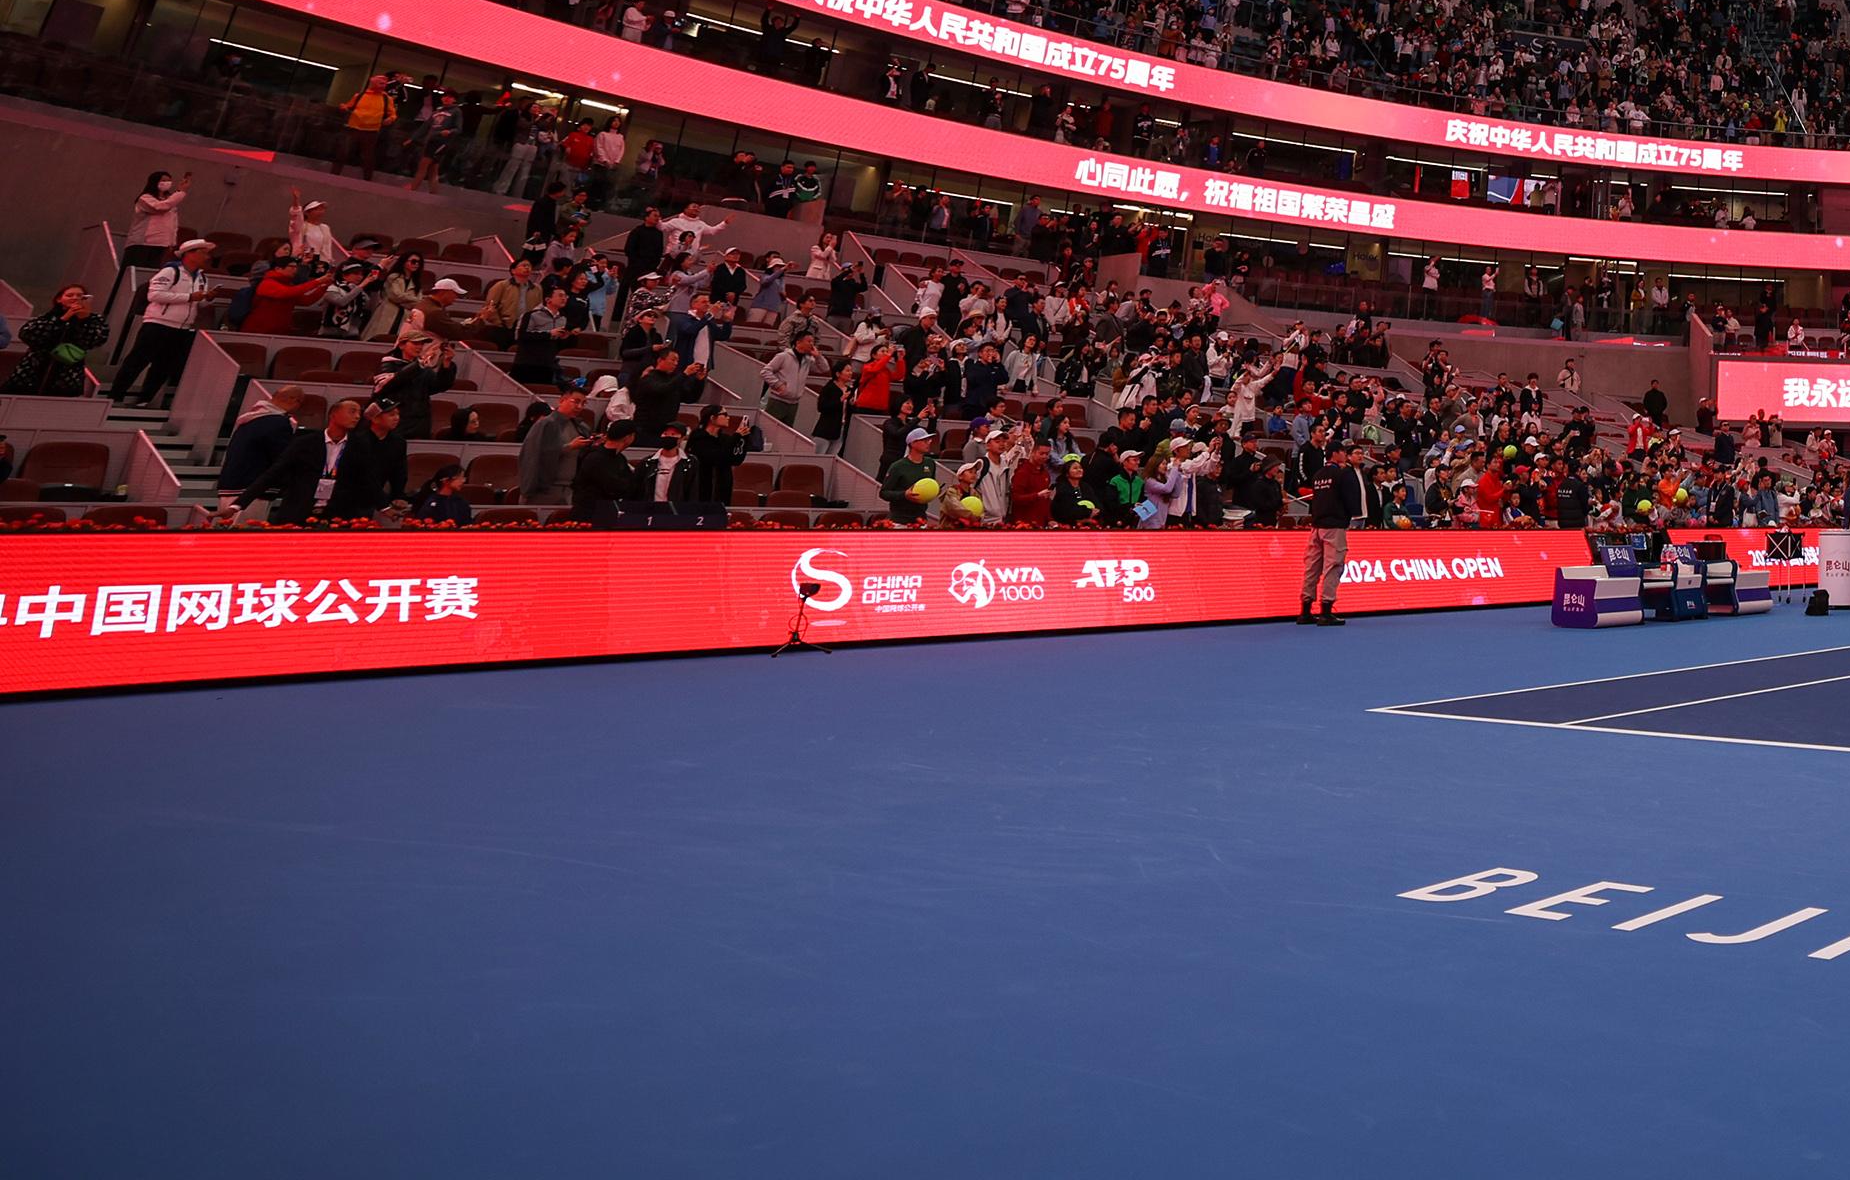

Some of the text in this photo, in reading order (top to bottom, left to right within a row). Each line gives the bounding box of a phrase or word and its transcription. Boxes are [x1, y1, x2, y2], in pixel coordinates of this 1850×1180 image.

[1445, 120, 1743, 172] 庆祝中华人民共和国成立75周年
[695, 516, 704, 526] 2
[1072, 559, 1150, 589] ATP
[1390, 559, 1451, 581] CHINA
[1451, 557, 1504, 579] OPEN
[1826, 560, 1850, 572] 昆仑山
[863, 575, 922, 590] CHINA
[996, 567, 1045, 583] WTA
[862, 589, 917, 604] OPEN
[999, 584, 1045, 601] 1000
[1123, 585, 1155, 602] 500
